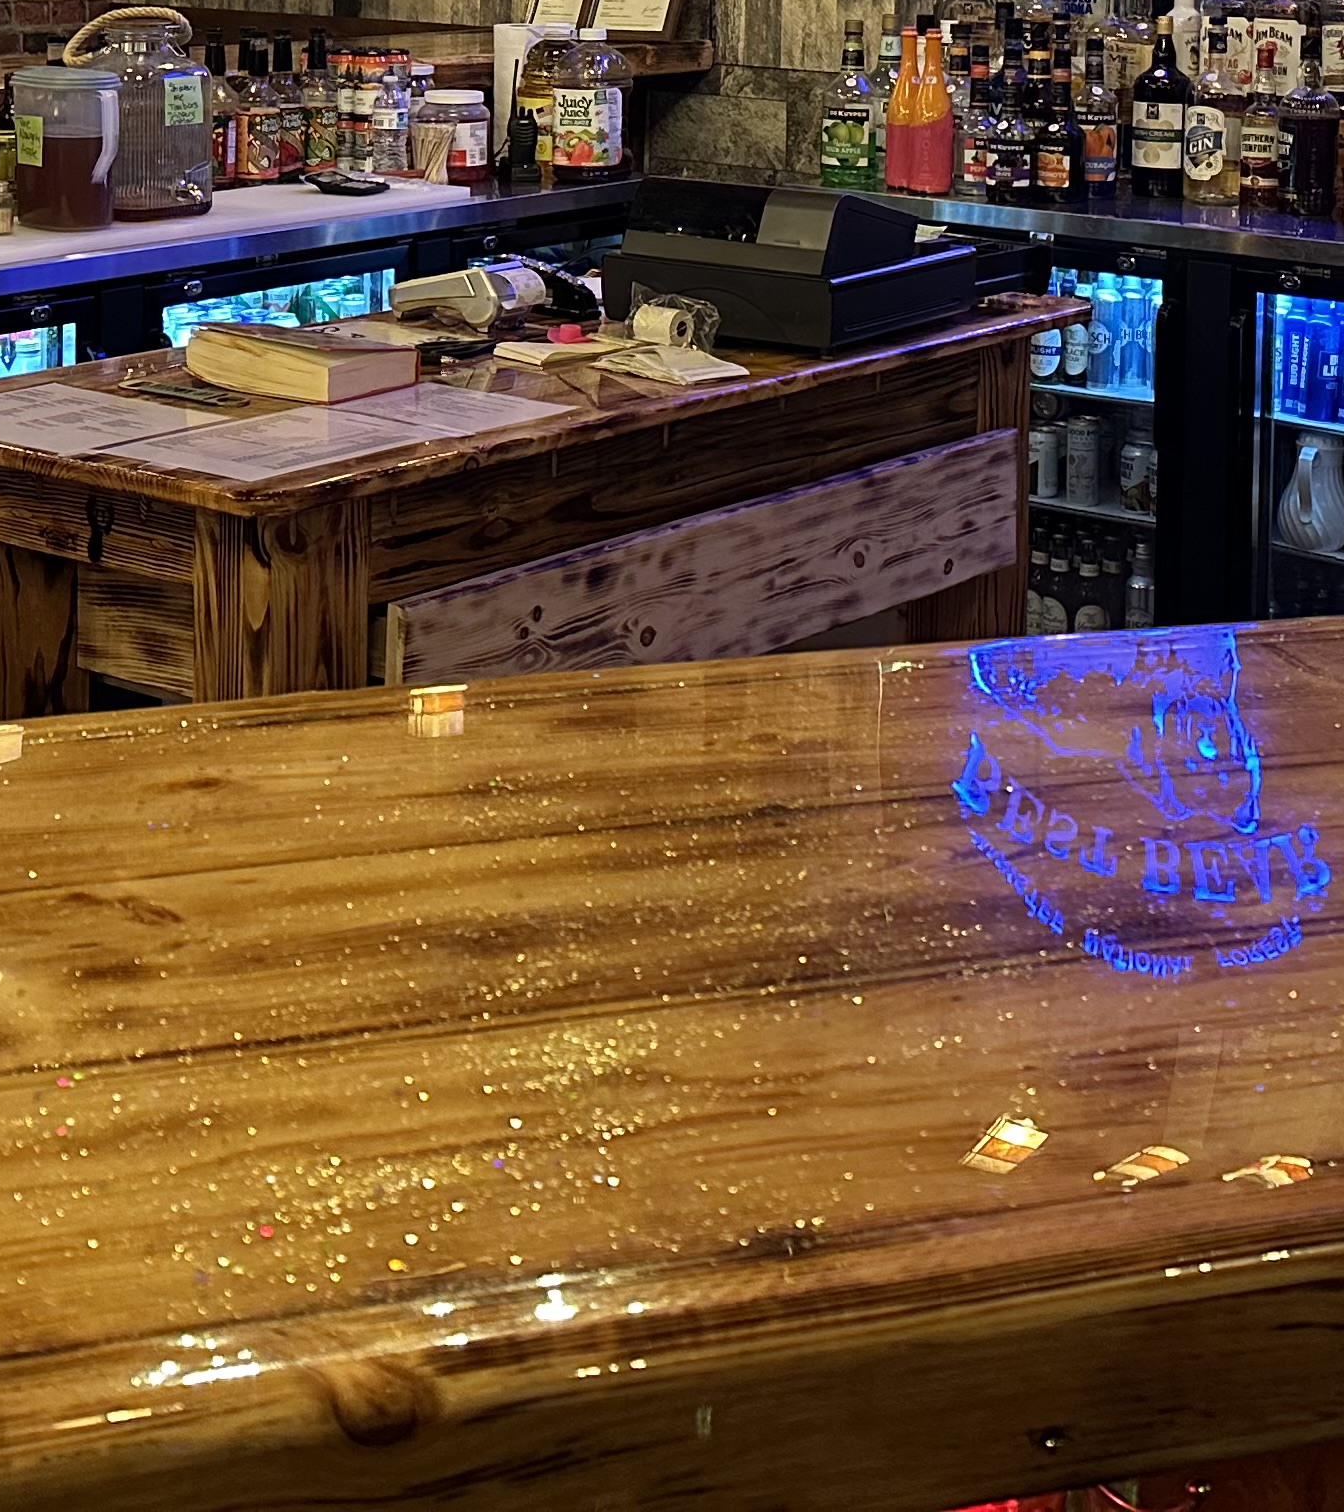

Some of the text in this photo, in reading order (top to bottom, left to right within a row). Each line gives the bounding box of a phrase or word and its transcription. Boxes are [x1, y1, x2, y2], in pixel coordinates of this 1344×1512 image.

[1255, 26, 1293, 48] JIM BEAM
[558, 95, 593, 109] Juicy
[560, 107, 589, 117] Juice
[1189, 136, 1215, 154] GIN
[1091, 332, 1112, 345] SCH
[1290, 334, 1299, 385] BUD LIGHT
